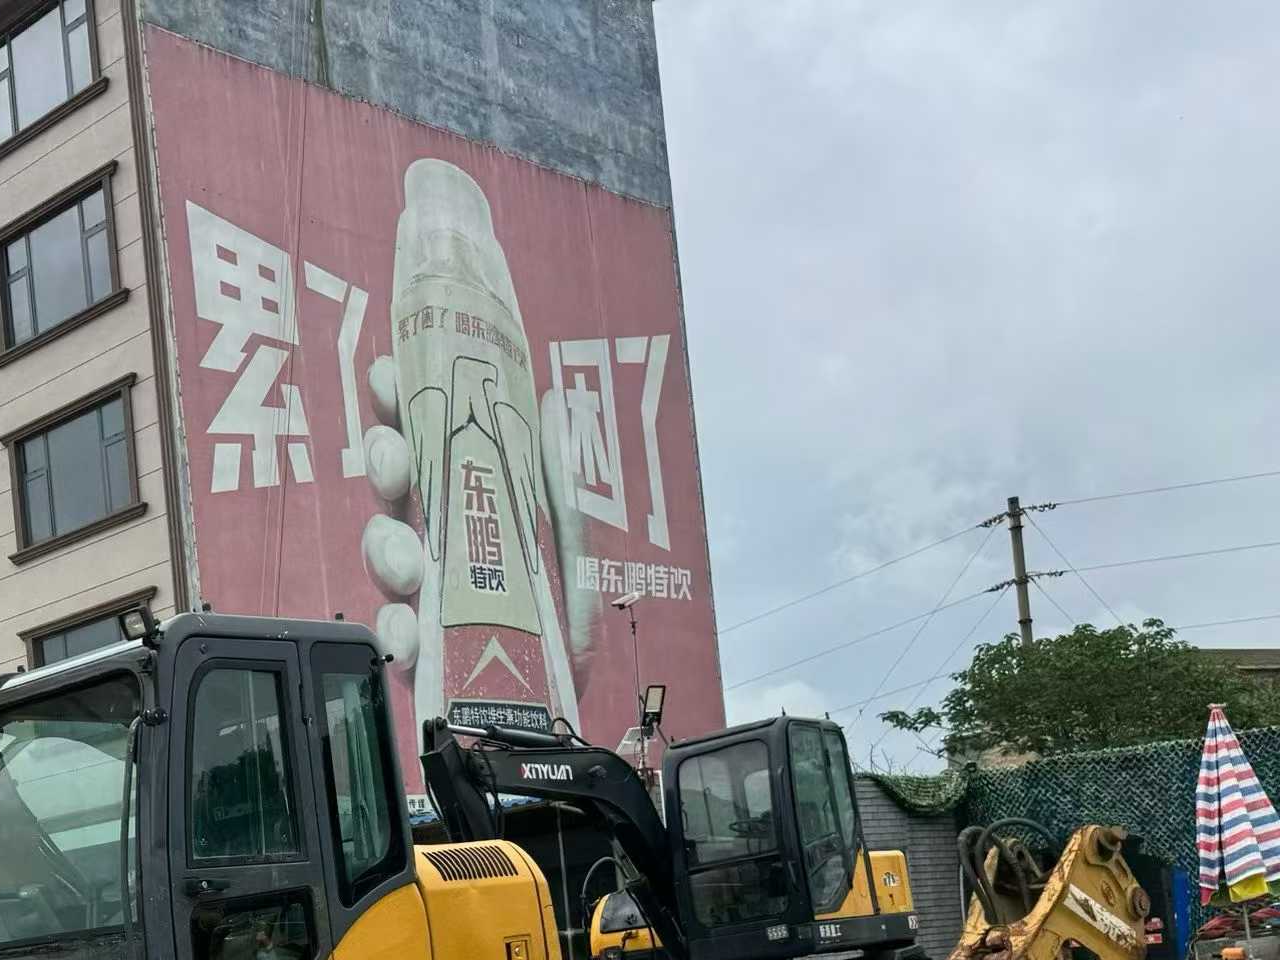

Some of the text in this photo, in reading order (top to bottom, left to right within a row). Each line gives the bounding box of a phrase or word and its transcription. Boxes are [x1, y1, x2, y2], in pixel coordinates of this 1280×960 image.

[185, 200, 671, 551] 累了 困了
[460, 460, 500, 566] 东鹏
[470, 566, 507, 594] 特饮
[576, 556, 692, 600] 喝东鹏特饮
[521, 763, 574, 781] XINYUAN
